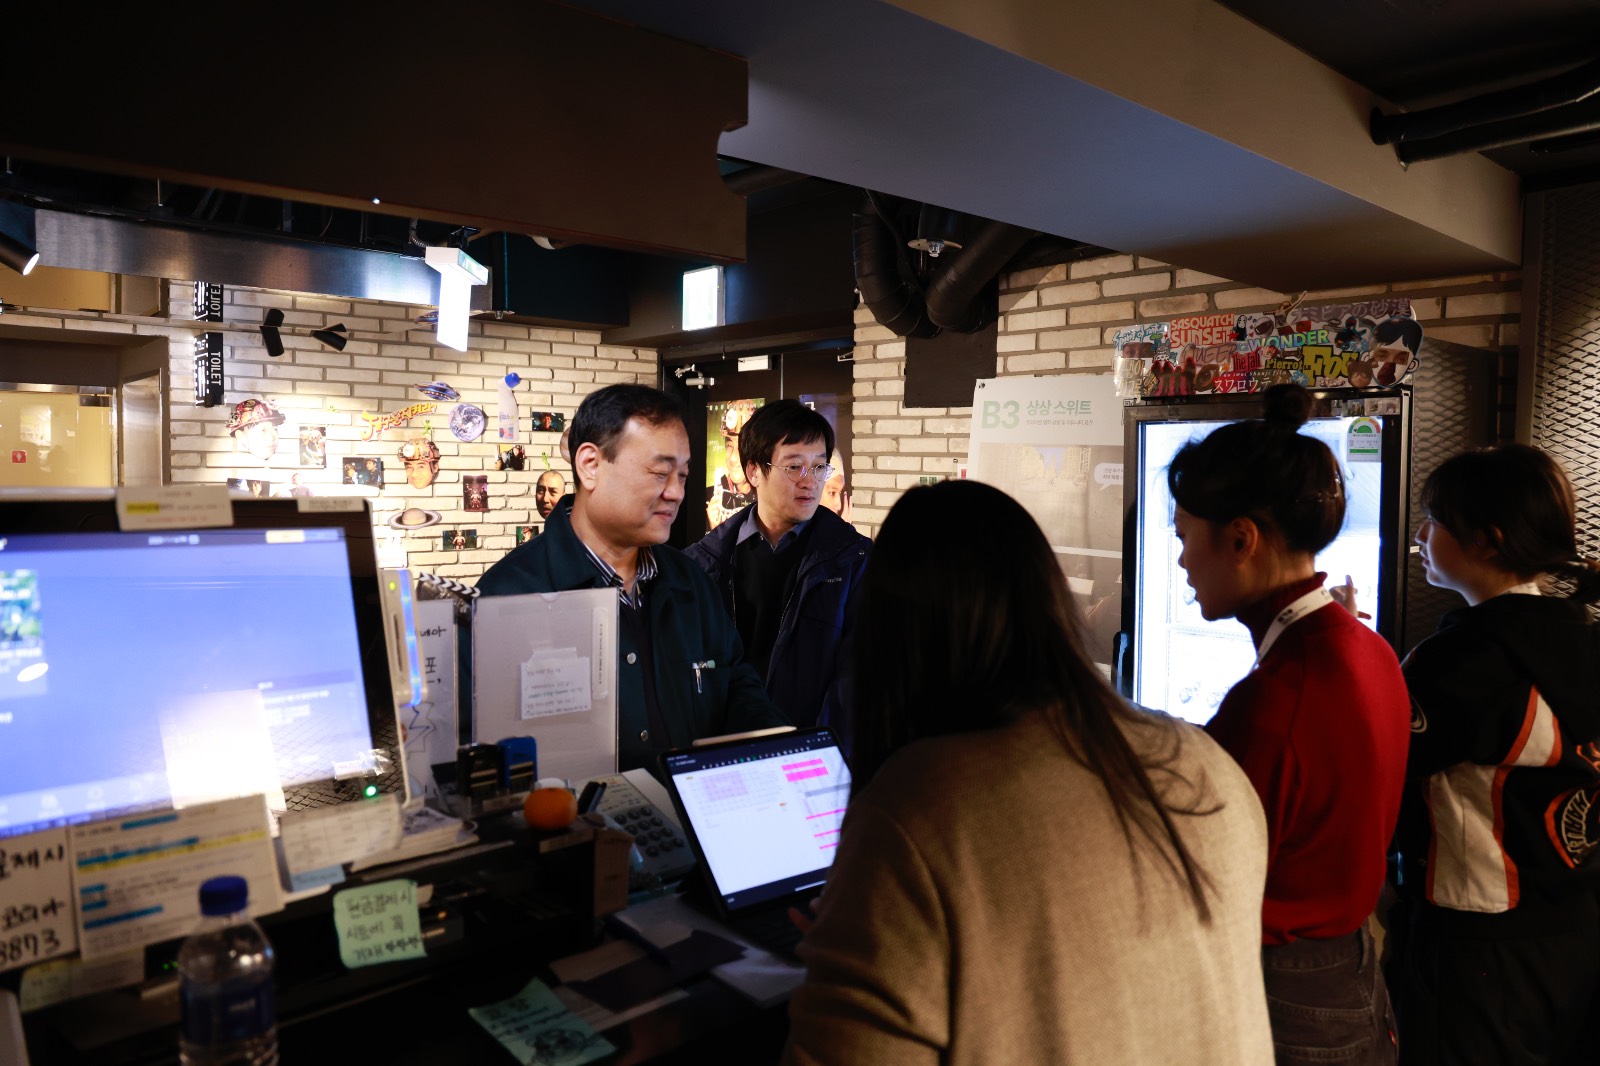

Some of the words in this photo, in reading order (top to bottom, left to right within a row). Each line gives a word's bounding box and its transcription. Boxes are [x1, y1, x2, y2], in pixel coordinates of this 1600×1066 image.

[1291, 299, 1411, 324] ナミビアの砂漠
[1171, 315, 1234, 331] SASQUATCH
[1171, 326, 1234, 349] SUNSET
[1248, 329, 1329, 351] WONDER
[210, 352, 222, 386] TOILET
[1265, 357, 1304, 371] Pierrot
[981, 400, 1020, 429] B3
[1026, 400, 1052, 415] 상상
[1053, 400, 1092, 416] 스위트
